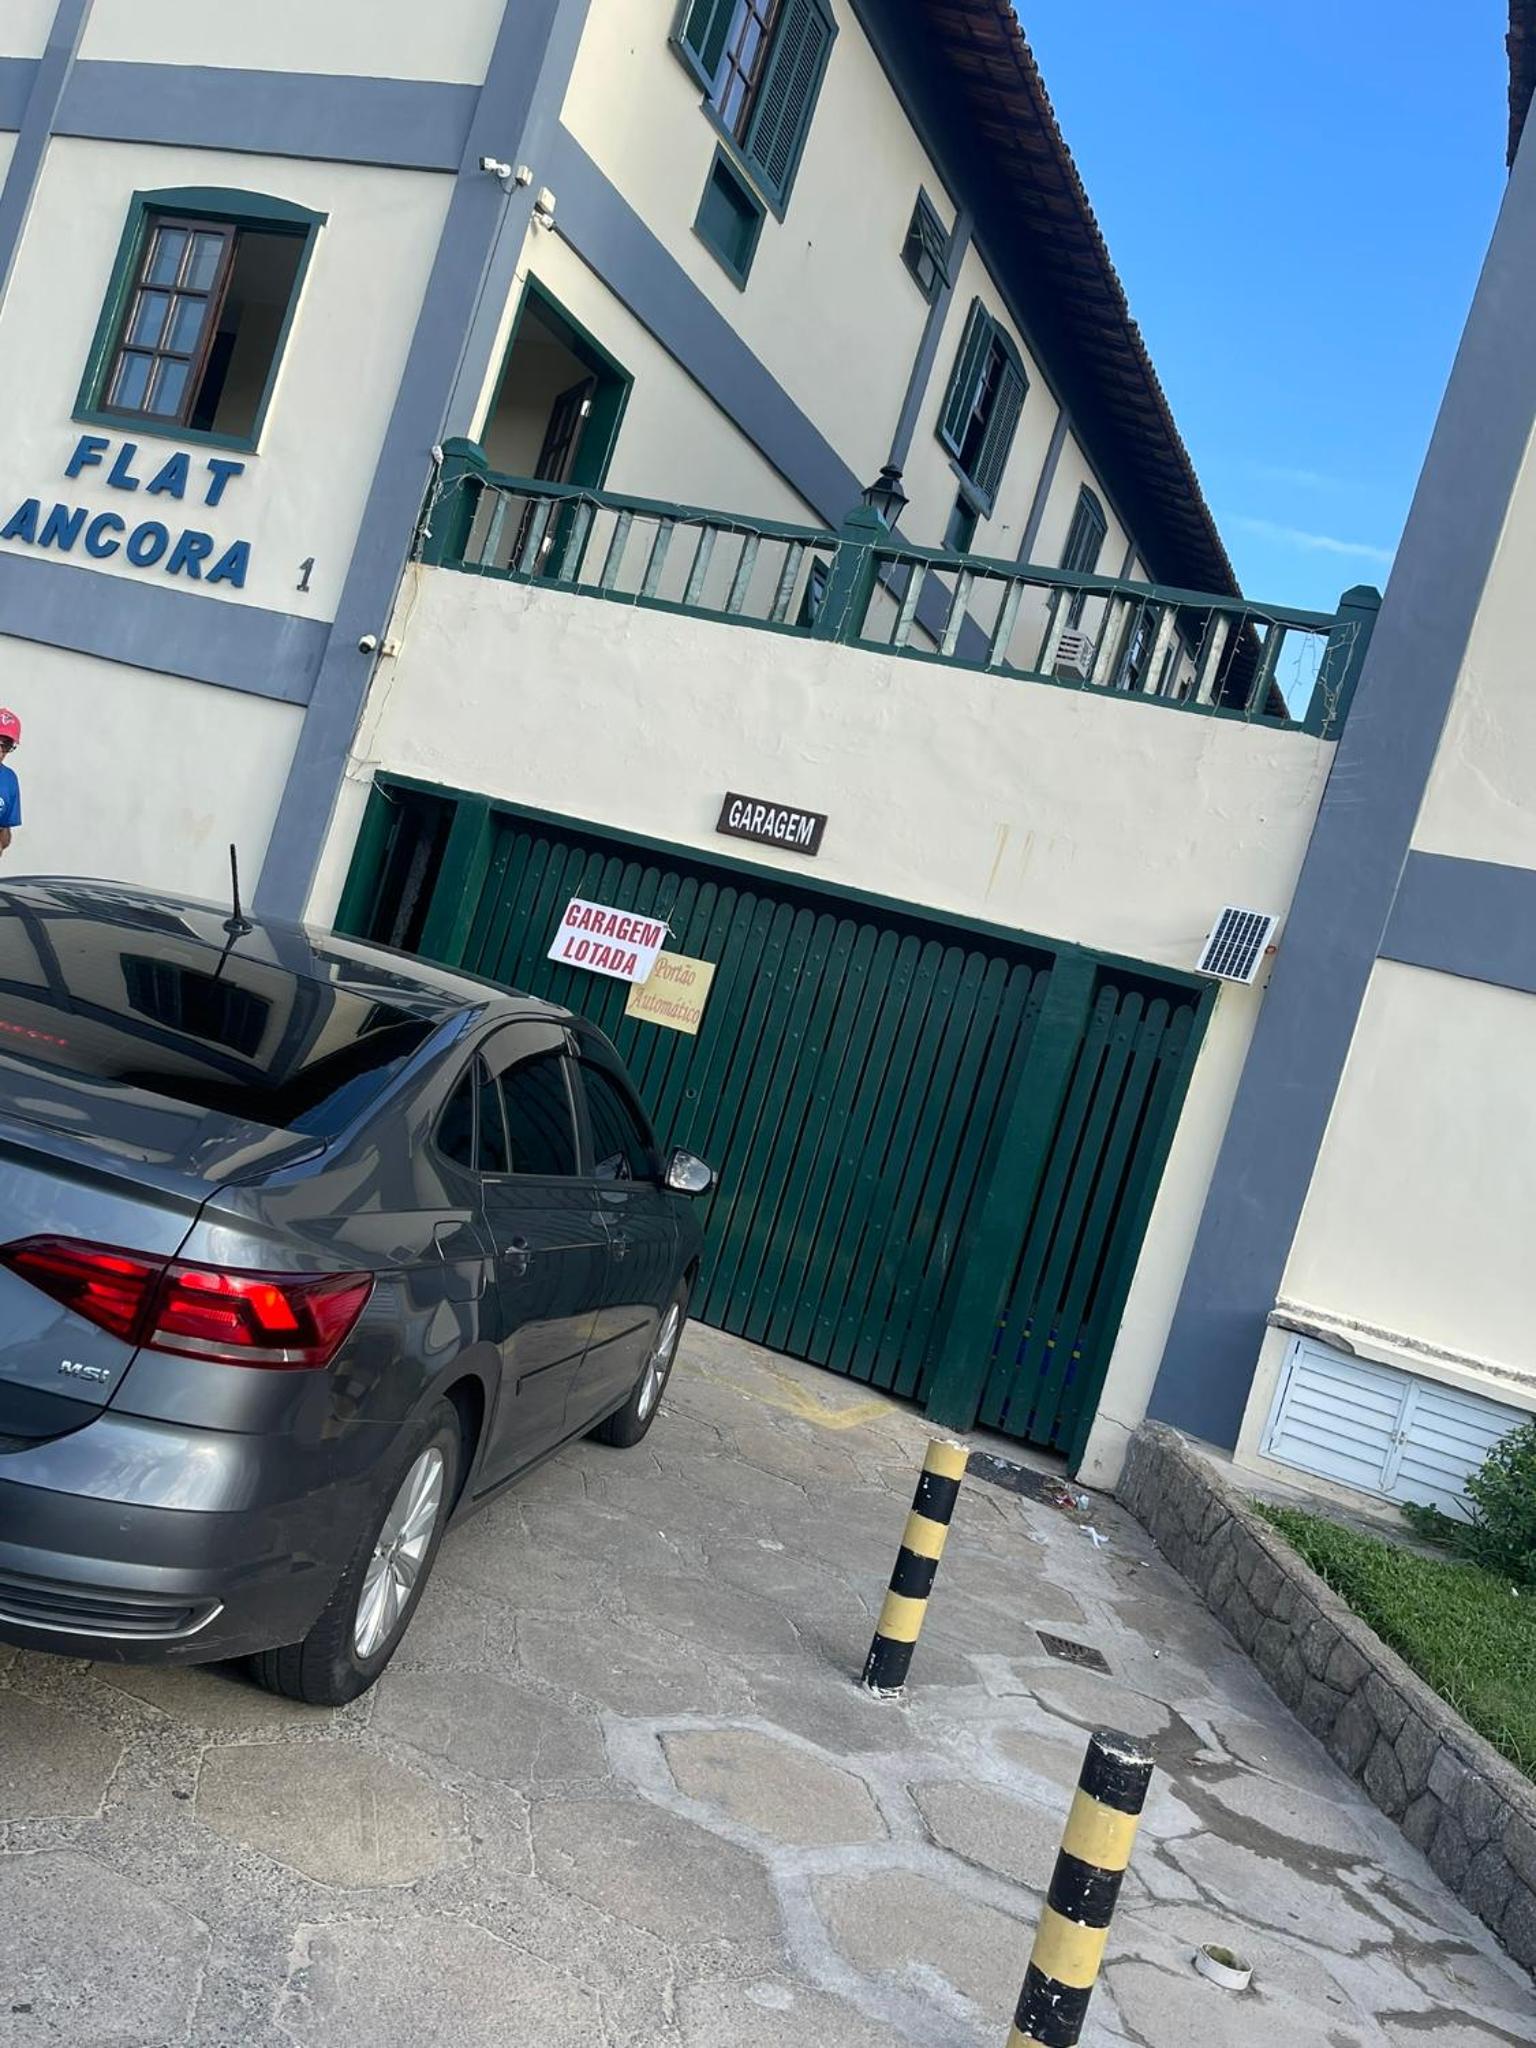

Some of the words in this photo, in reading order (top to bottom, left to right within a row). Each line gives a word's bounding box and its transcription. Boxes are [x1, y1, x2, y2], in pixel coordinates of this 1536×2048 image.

[64, 434, 246, 507] FLAT
[0, 498, 252, 588] ANCORA
[295, 556, 315, 592] 1
[728, 800, 816, 846] GARAGEM
[565, 904, 662, 949] GARAGEM
[563, 936, 638, 975] LOTADA
[654, 957, 697, 986] Portão
